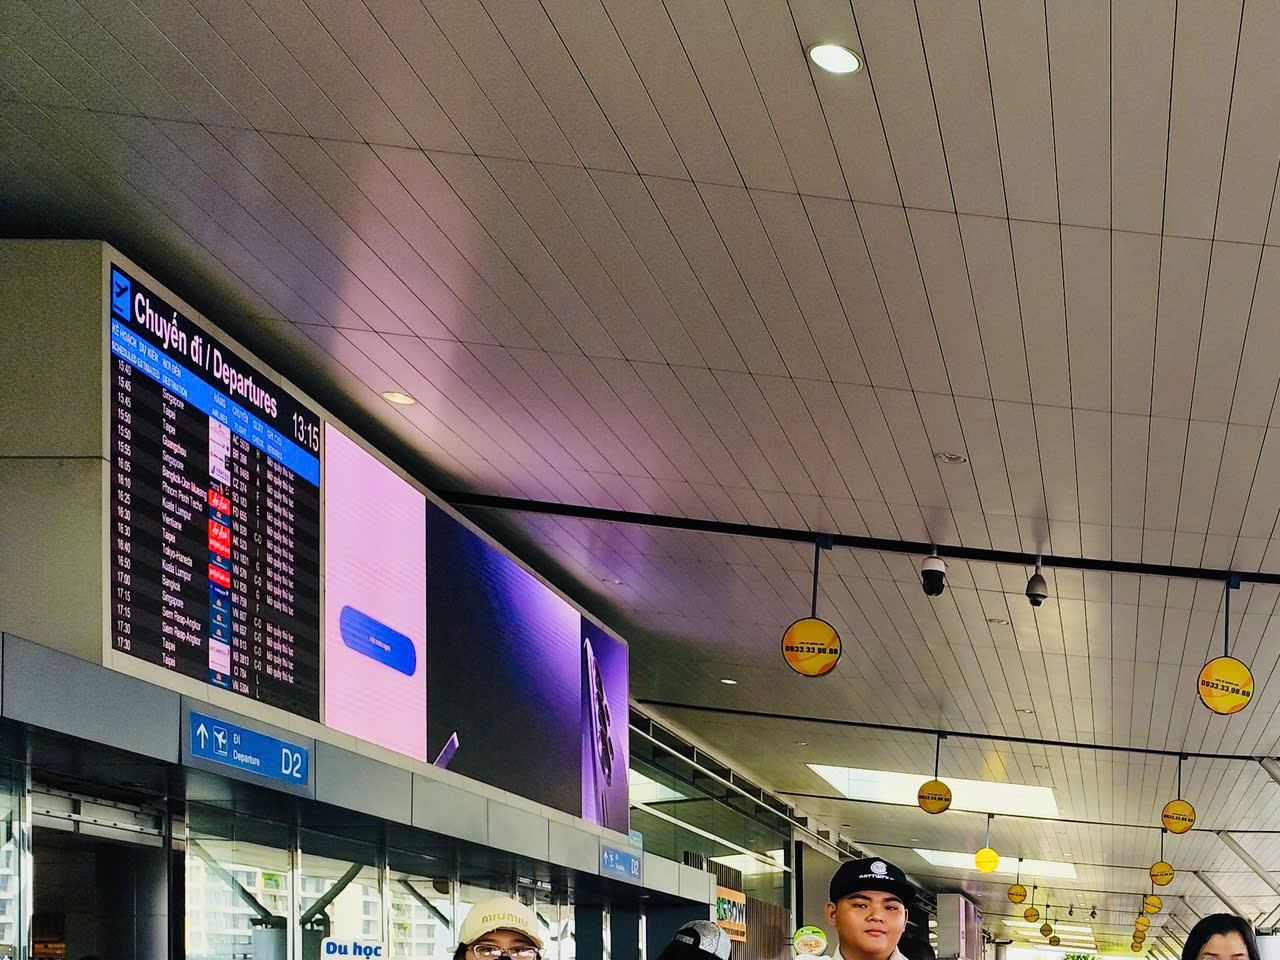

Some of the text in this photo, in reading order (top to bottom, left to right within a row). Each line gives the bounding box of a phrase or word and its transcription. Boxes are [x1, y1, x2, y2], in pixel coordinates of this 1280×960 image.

[118, 360, 184, 410] 15:40 Singapore
[134, 292, 187, 356] Chuyến
[190, 334, 204, 367] đi
[214, 348, 278, 419] Departures
[293, 412, 320, 452] 13:15
[118, 376, 131, 392] 15:45
[163, 403, 176, 420] Taipei
[118, 392, 176, 435] 15:45 Taipei
[118, 408, 131, 424] 15:50
[162, 434, 187, 457] Guangzhou
[118, 424, 131, 440] 15:50
[162, 450, 184, 470] Singapore
[118, 457, 131, 472] 16:05
[118, 473, 192, 520] 16:10 Kuala Lumpur
[118, 490, 182, 531] 16:25 Vientiane
[118, 506, 176, 543] 16:30 Taipei
[118, 522, 131, 537] 16:30
[118, 538, 191, 581] 16:40 Kuala Lumpur
[118, 555, 180, 592] 16:50 Bangkok
[118, 571, 184, 608] 17:00 Singapore
[118, 588, 131, 601] 17:15
[162, 606, 173, 619] Siem
[118, 604, 131, 618] 17:15
[162, 621, 173, 635] Siem
[118, 620, 131, 634] 17:30
[162, 637, 176, 652] Taipei
[118, 637, 131, 650] 17:30
[162, 653, 176, 667] Taipei
[233, 733, 241, 746] ĐI
[233, 750, 260, 767] Departure
[282, 748, 302, 778] D2
[630, 858, 639, 876] D2
[326, 941, 382, 960] Du học
